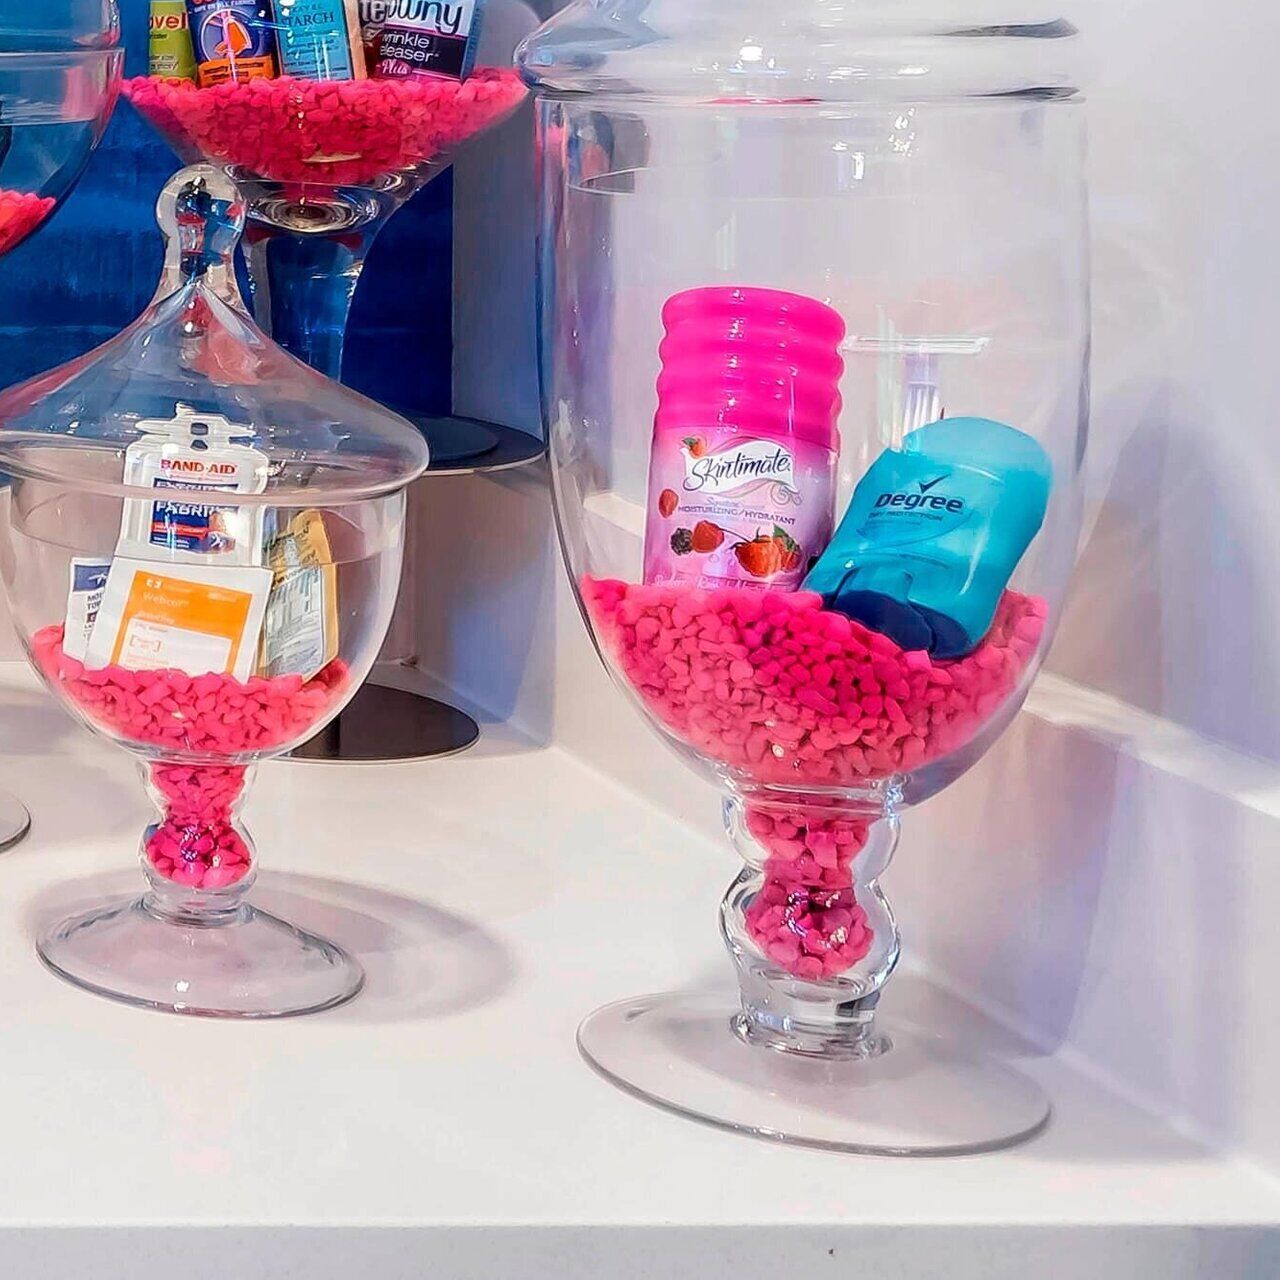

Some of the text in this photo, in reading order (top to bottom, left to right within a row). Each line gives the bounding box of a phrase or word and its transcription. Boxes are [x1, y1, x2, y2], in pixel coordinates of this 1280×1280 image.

[149, 12, 186, 29] vel
[682, 448, 791, 491] Skintimate
[873, 493, 964, 514] Degree
